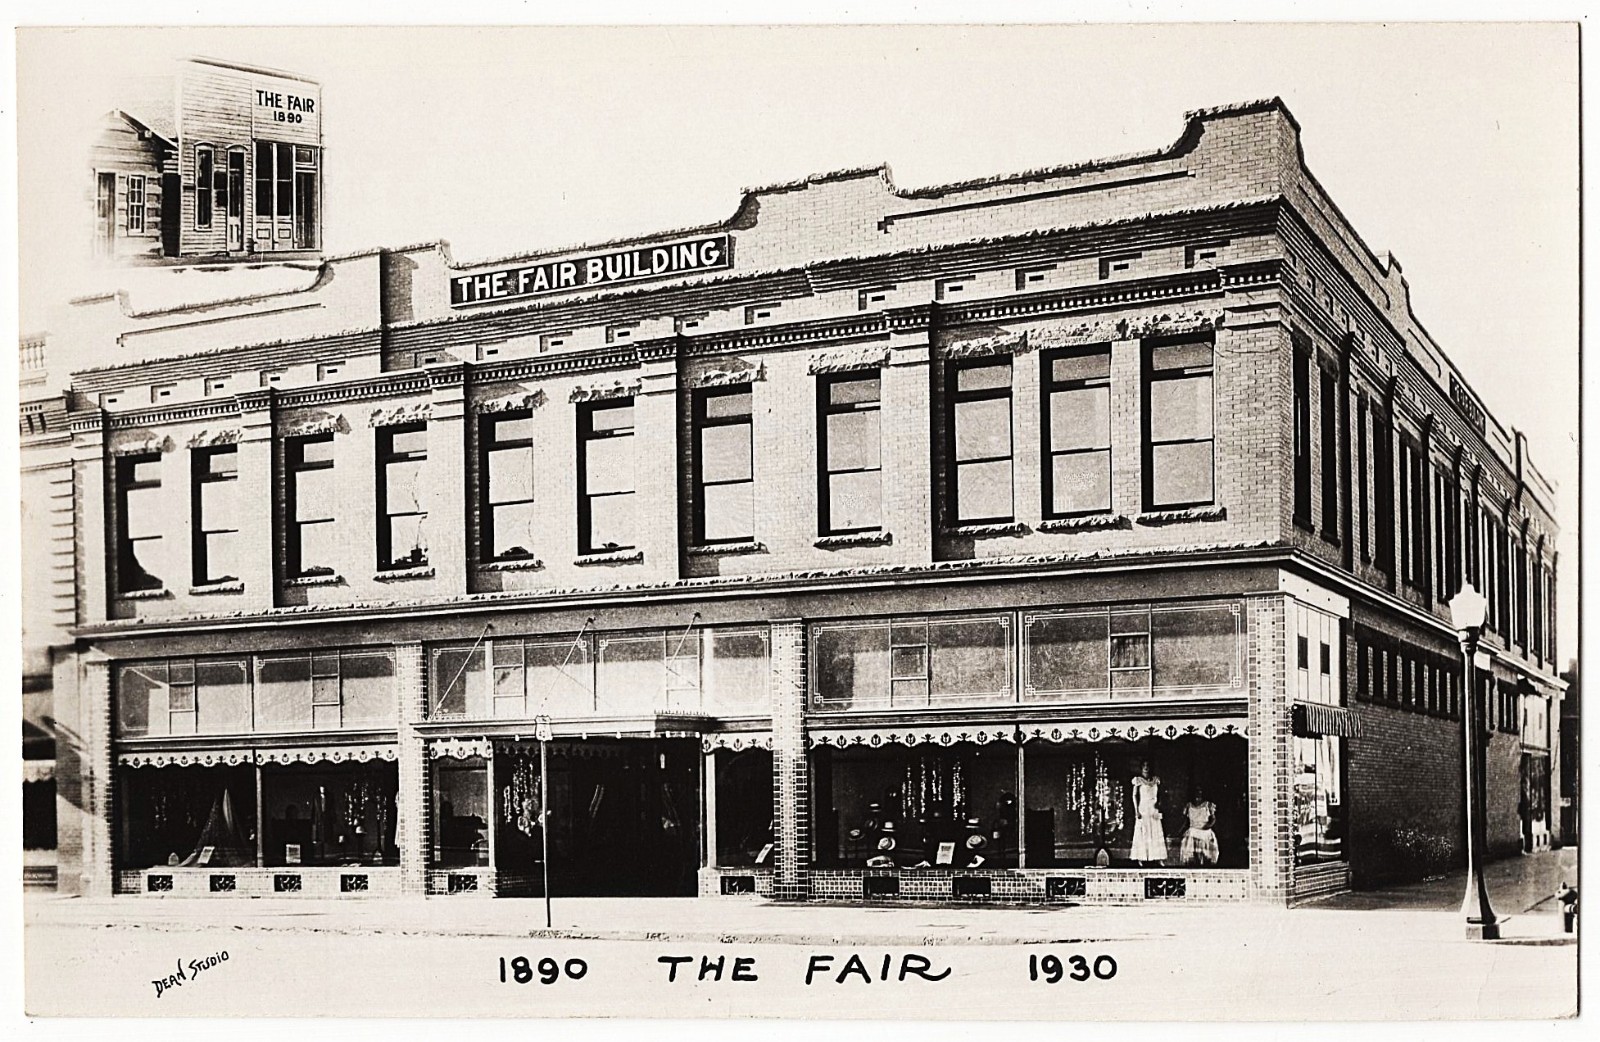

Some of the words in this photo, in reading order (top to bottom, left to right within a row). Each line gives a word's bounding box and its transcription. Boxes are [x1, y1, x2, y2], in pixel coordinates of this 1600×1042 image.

[256, 89, 283, 108] THE
[287, 94, 315, 113] FAIR
[274, 110, 303, 124] 1890
[457, 271, 508, 302] THE
[517, 262, 578, 294] FAIR
[586, 240, 721, 285] BUILDING
